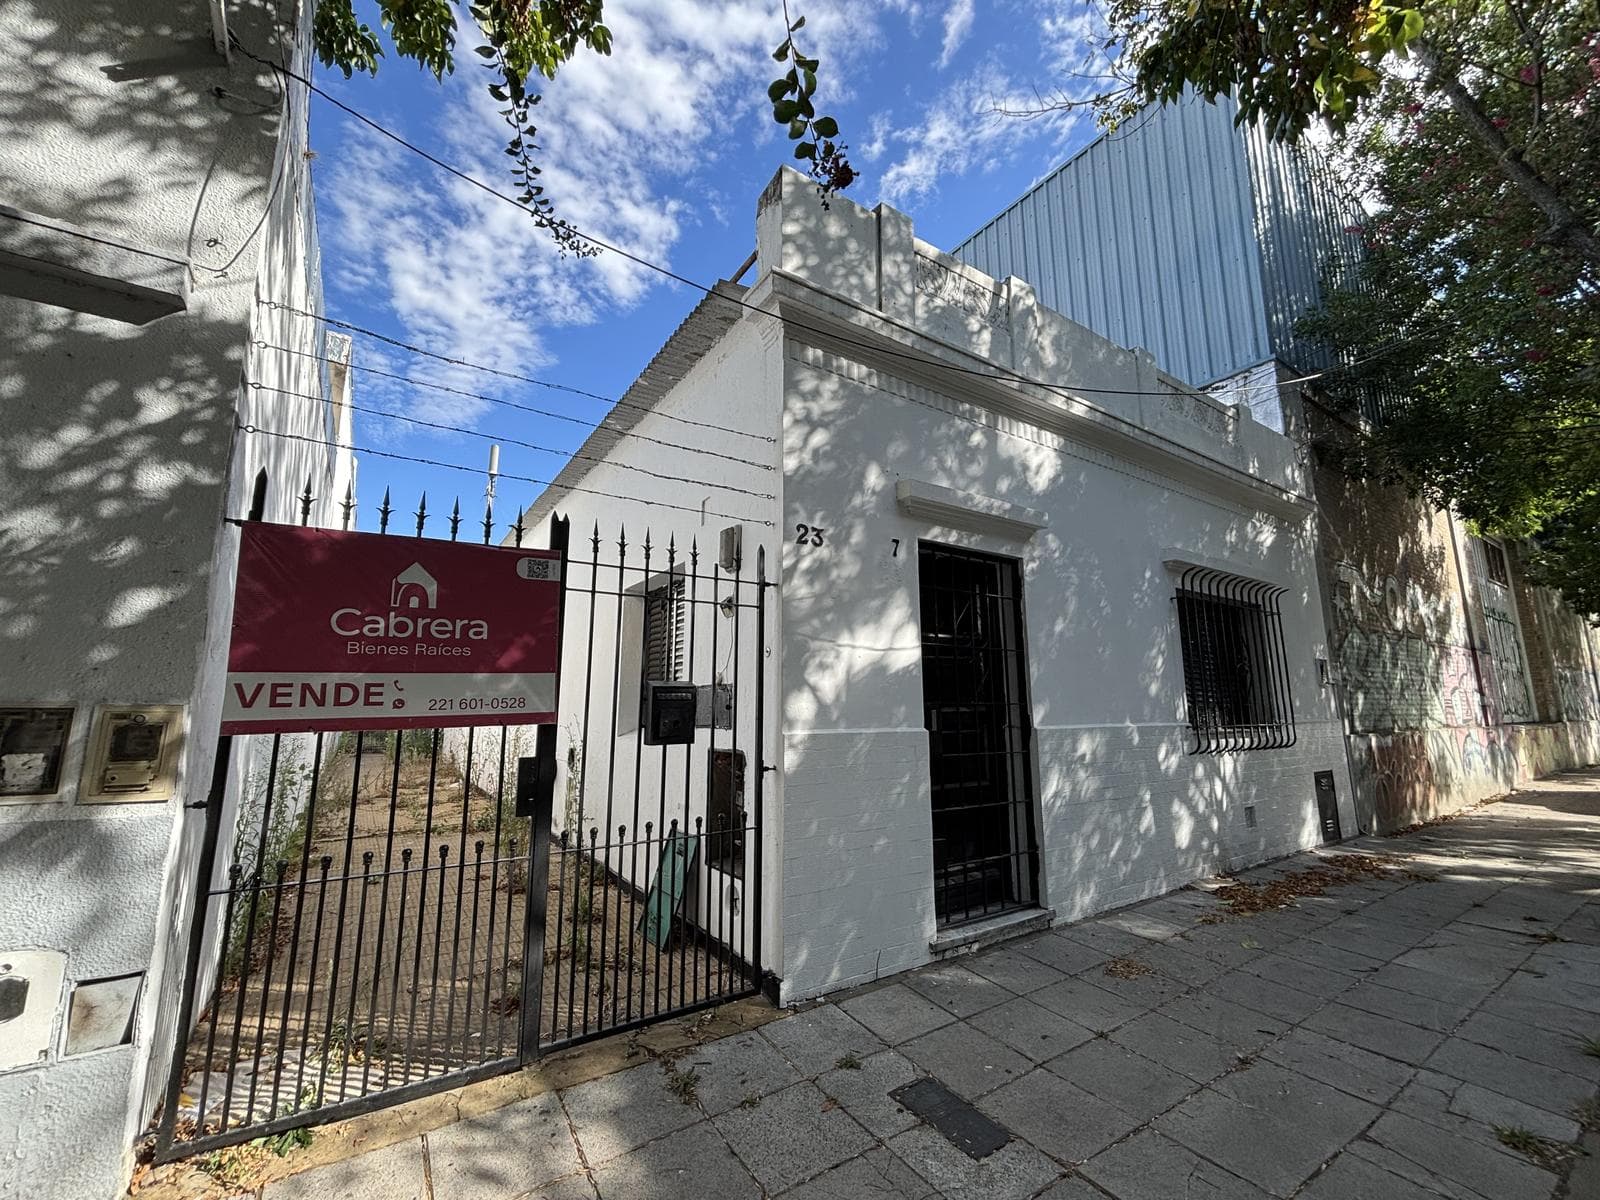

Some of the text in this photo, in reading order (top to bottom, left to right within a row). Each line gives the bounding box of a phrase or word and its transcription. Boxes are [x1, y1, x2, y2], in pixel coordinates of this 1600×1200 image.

[795, 523, 825, 547] 23
[891, 538, 900, 557] 7
[330, 608, 489, 639] Cabrera
[347, 641, 472, 656] Bienes Raíces
[234, 682, 386, 708] VENDE
[428, 697, 527, 711] 221 601-0528
